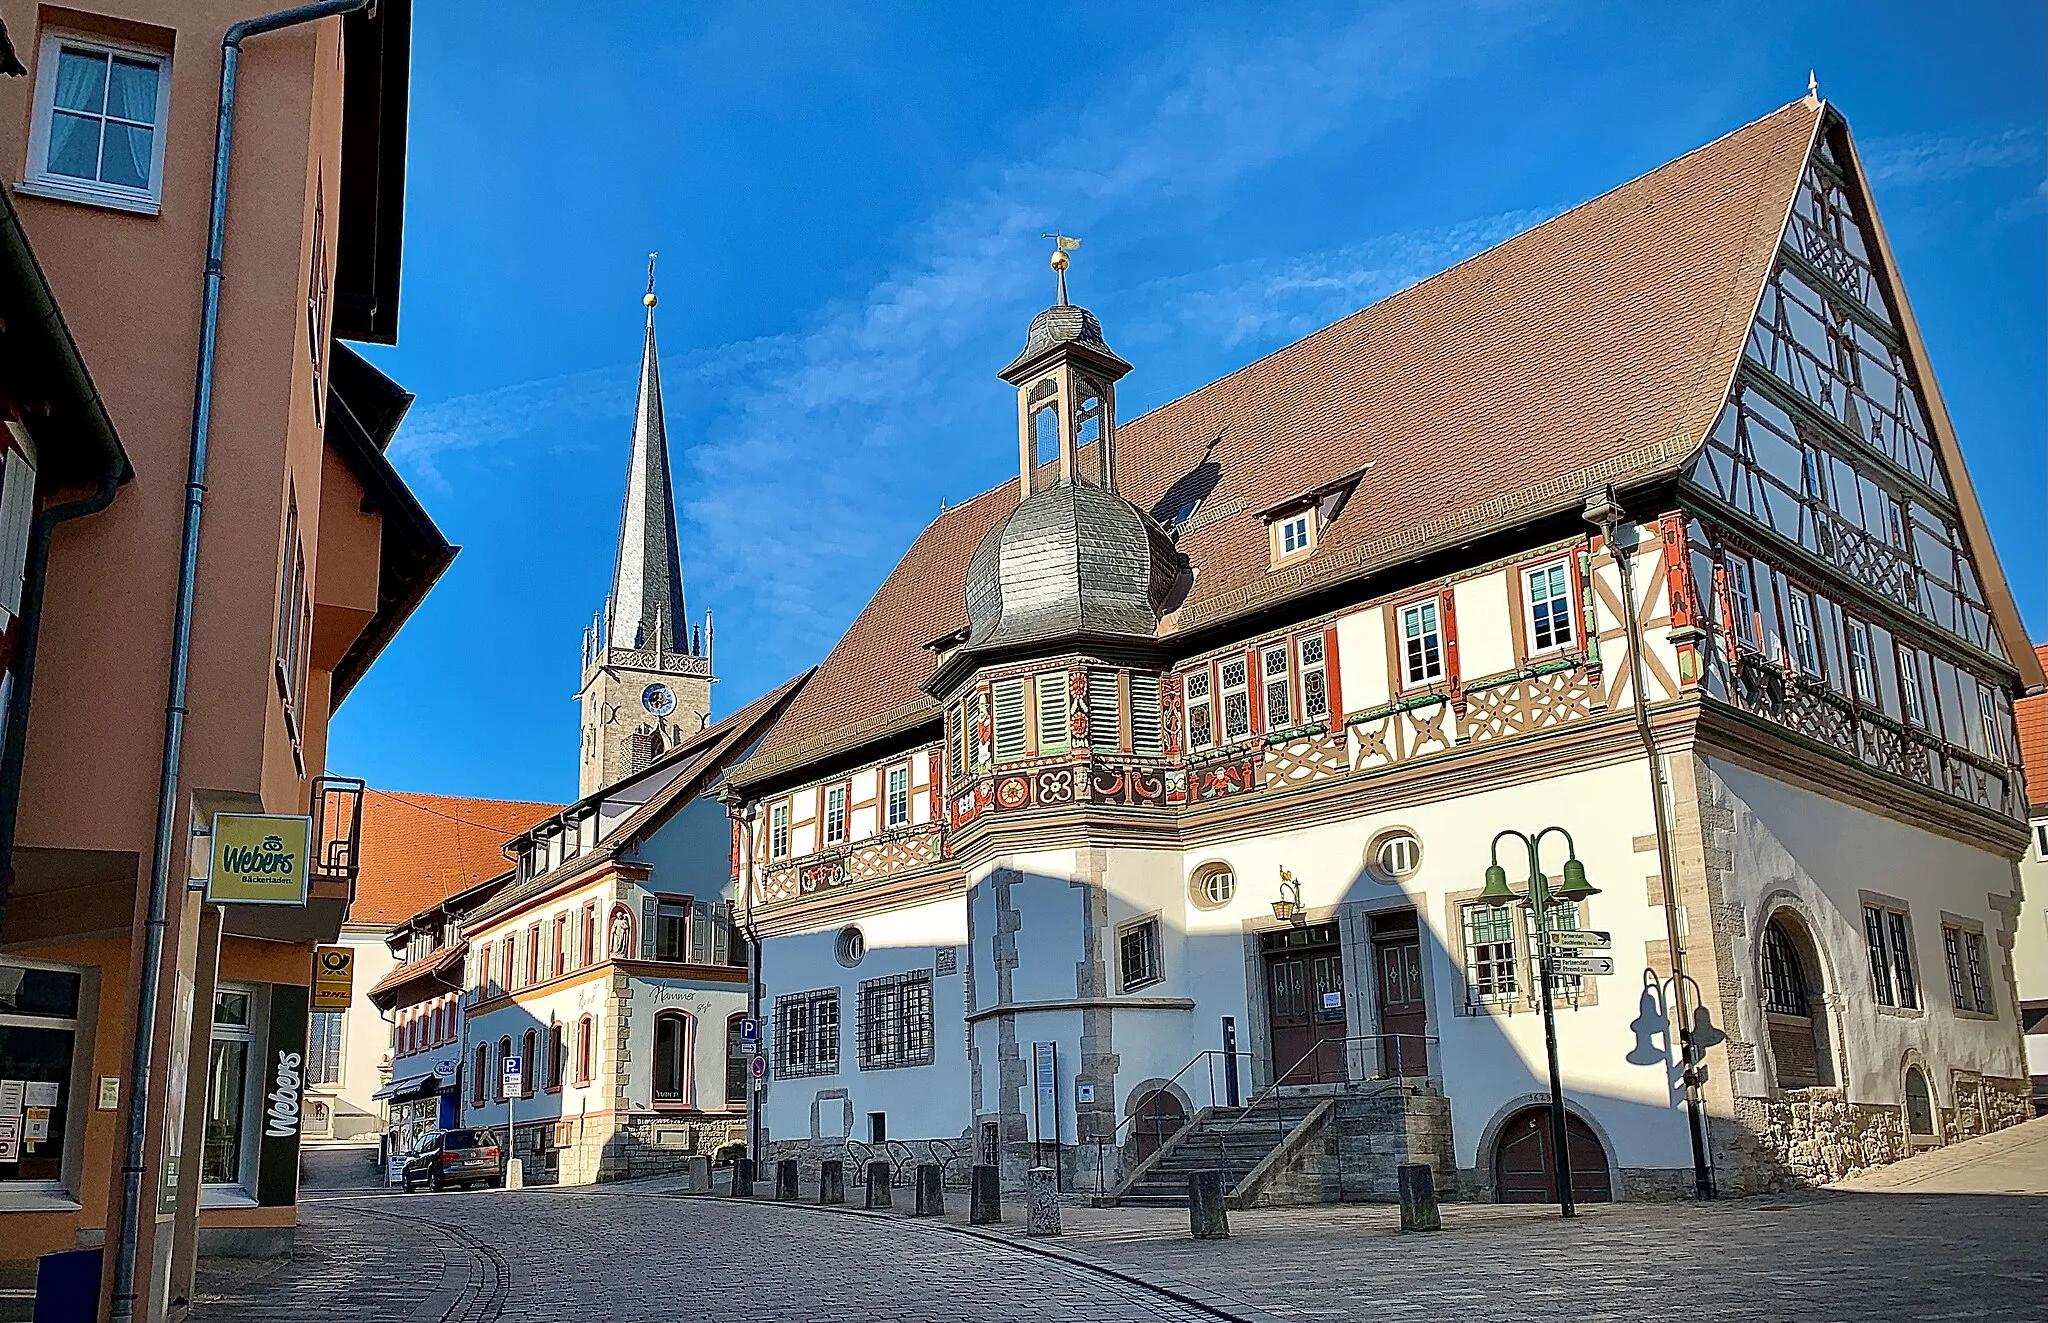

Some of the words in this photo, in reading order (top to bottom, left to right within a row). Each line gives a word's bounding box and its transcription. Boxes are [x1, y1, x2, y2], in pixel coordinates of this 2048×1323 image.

[223, 844, 295, 875] Webers
[745, 1022, 754, 1037] P
[506, 1059, 517, 1073] P
[266, 1050, 301, 1137] Webers
